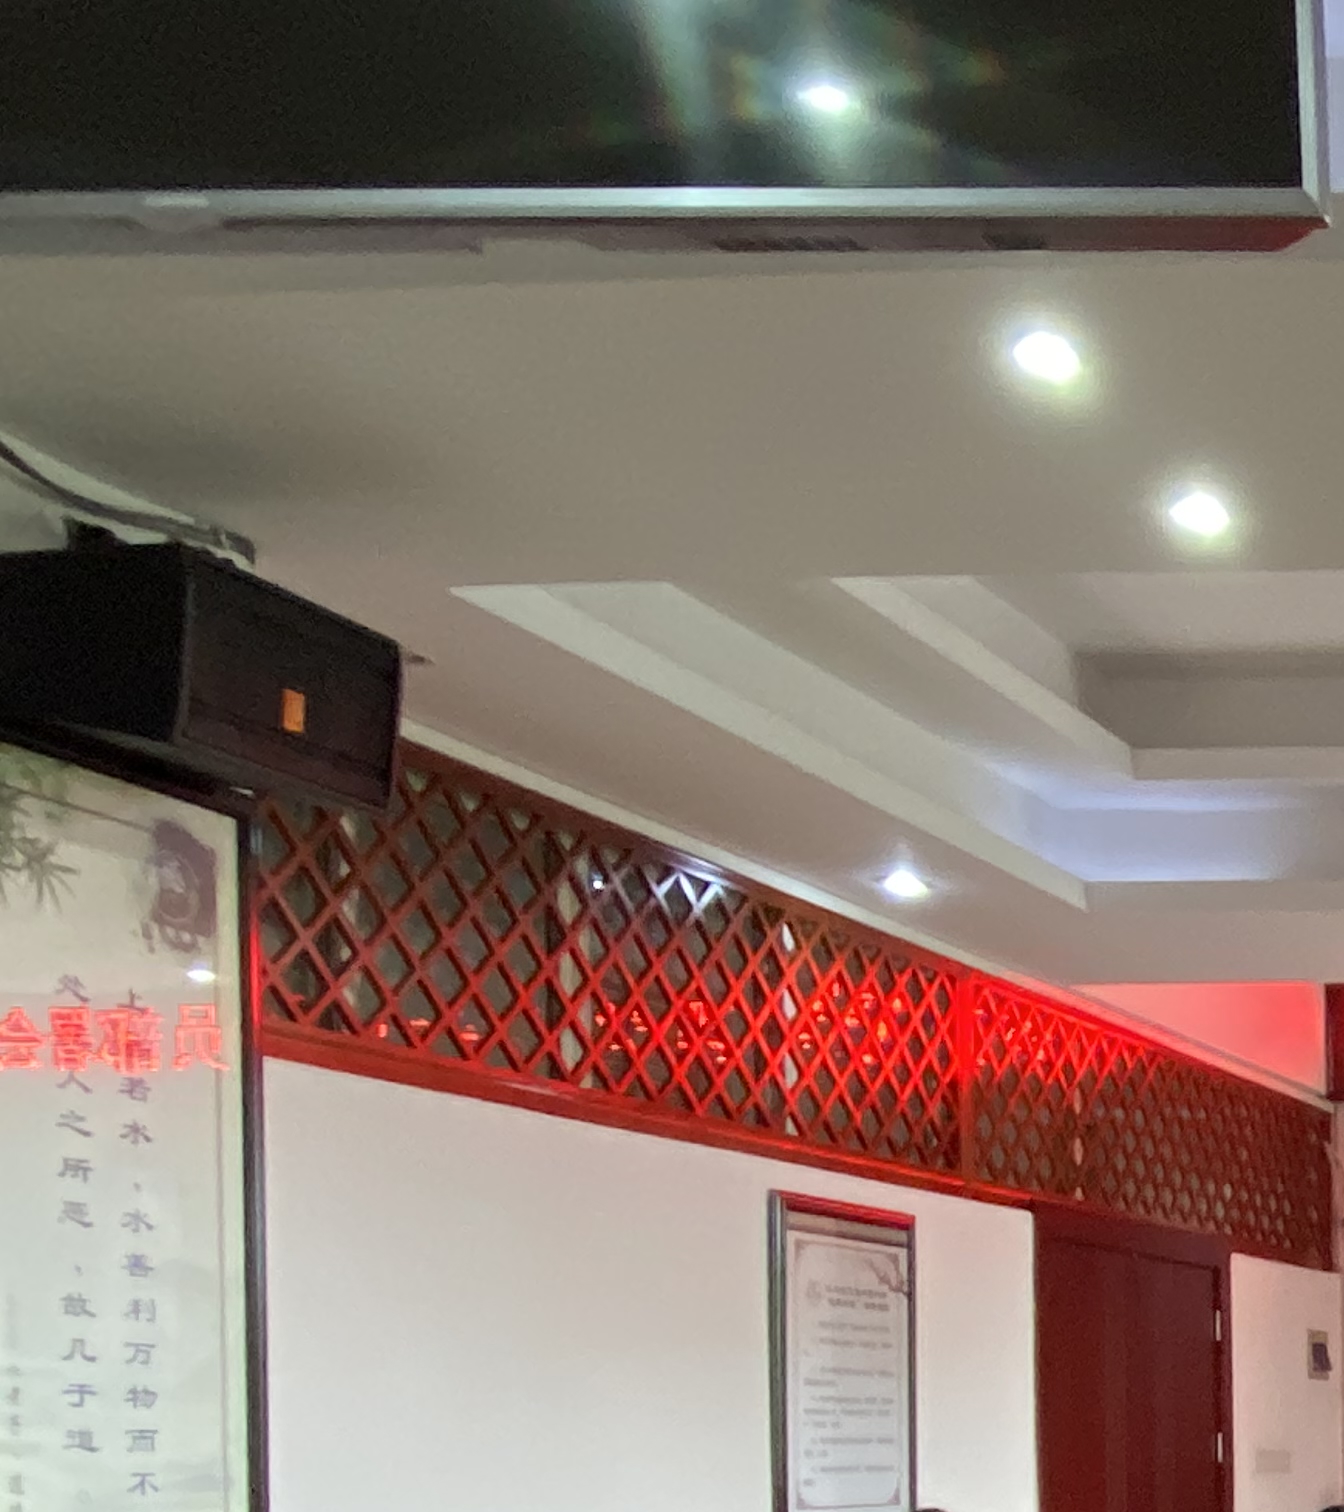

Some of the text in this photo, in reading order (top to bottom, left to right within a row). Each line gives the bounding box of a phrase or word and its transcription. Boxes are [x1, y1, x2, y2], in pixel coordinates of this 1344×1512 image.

[54, 973, 101, 1454] 处人之所恶，故几于道
